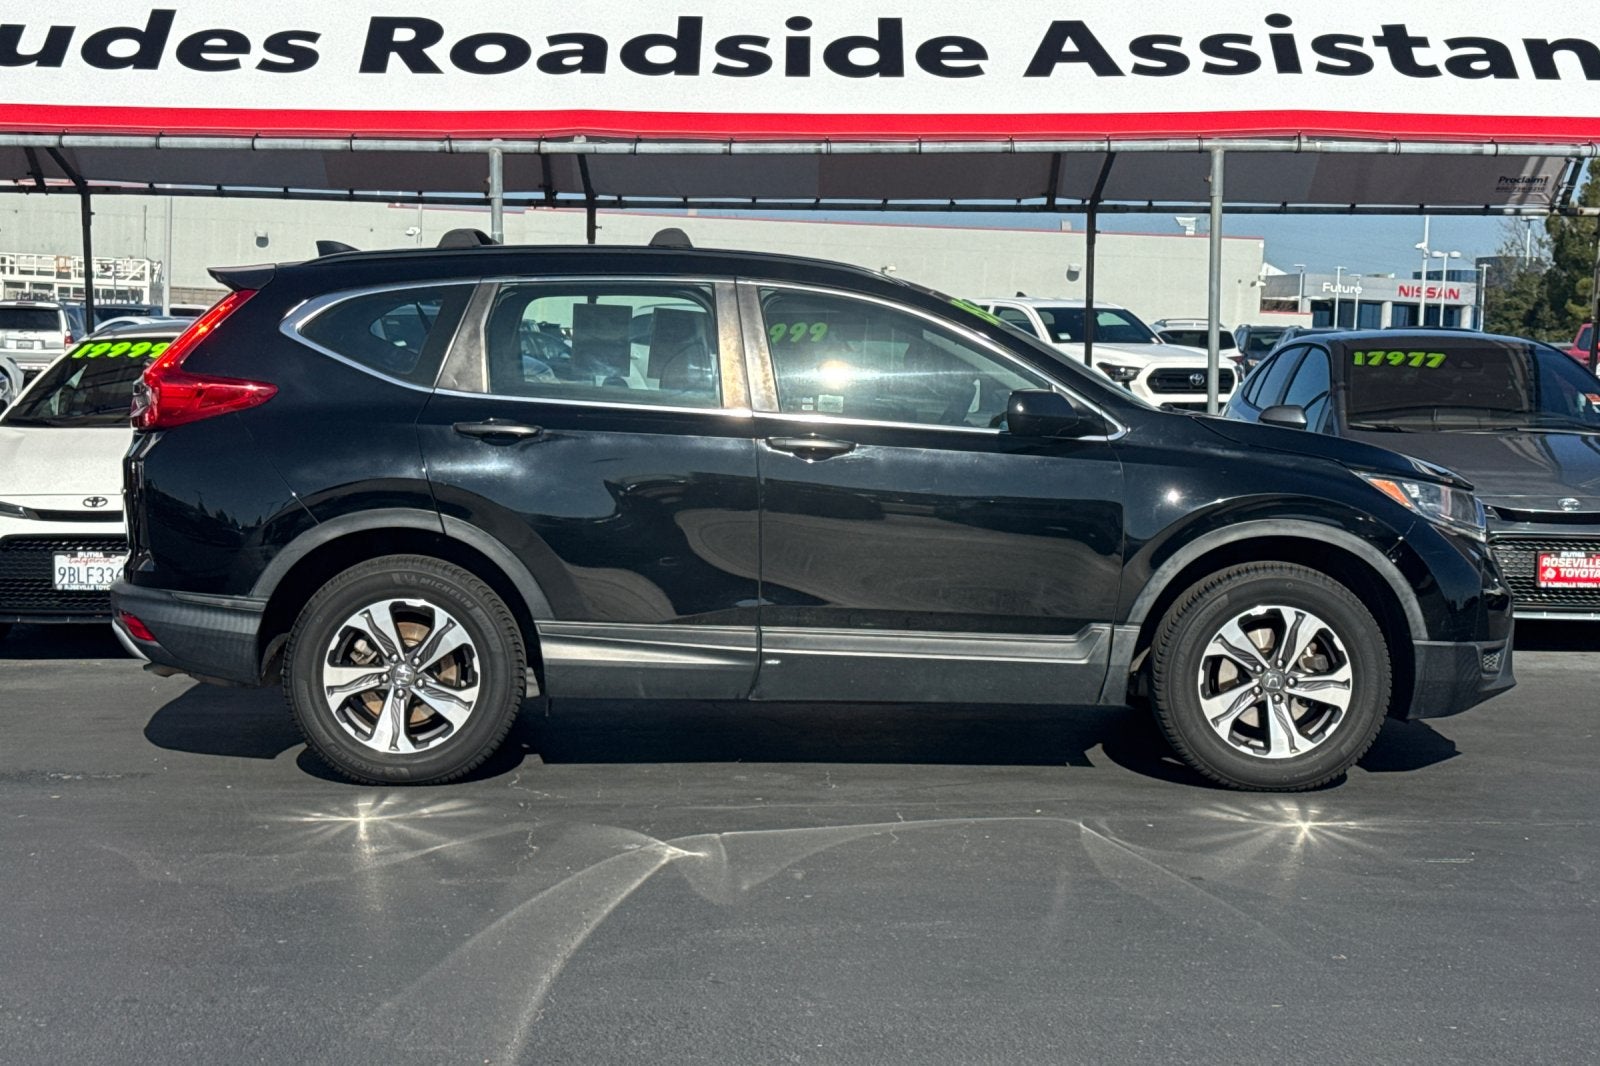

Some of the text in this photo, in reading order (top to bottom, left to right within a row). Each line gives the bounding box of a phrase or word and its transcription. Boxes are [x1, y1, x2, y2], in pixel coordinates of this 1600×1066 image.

[0, 8, 1600, 82] udes Roadside Assistan
[1322, 282, 1460, 300] Future NISSAN
[71, 341, 170, 359] 19999
[1353, 351, 1446, 368] 17977
[1541, 557, 1600, 567] ROSEVILLE
[1560, 567, 1600, 578] TOYOTA
